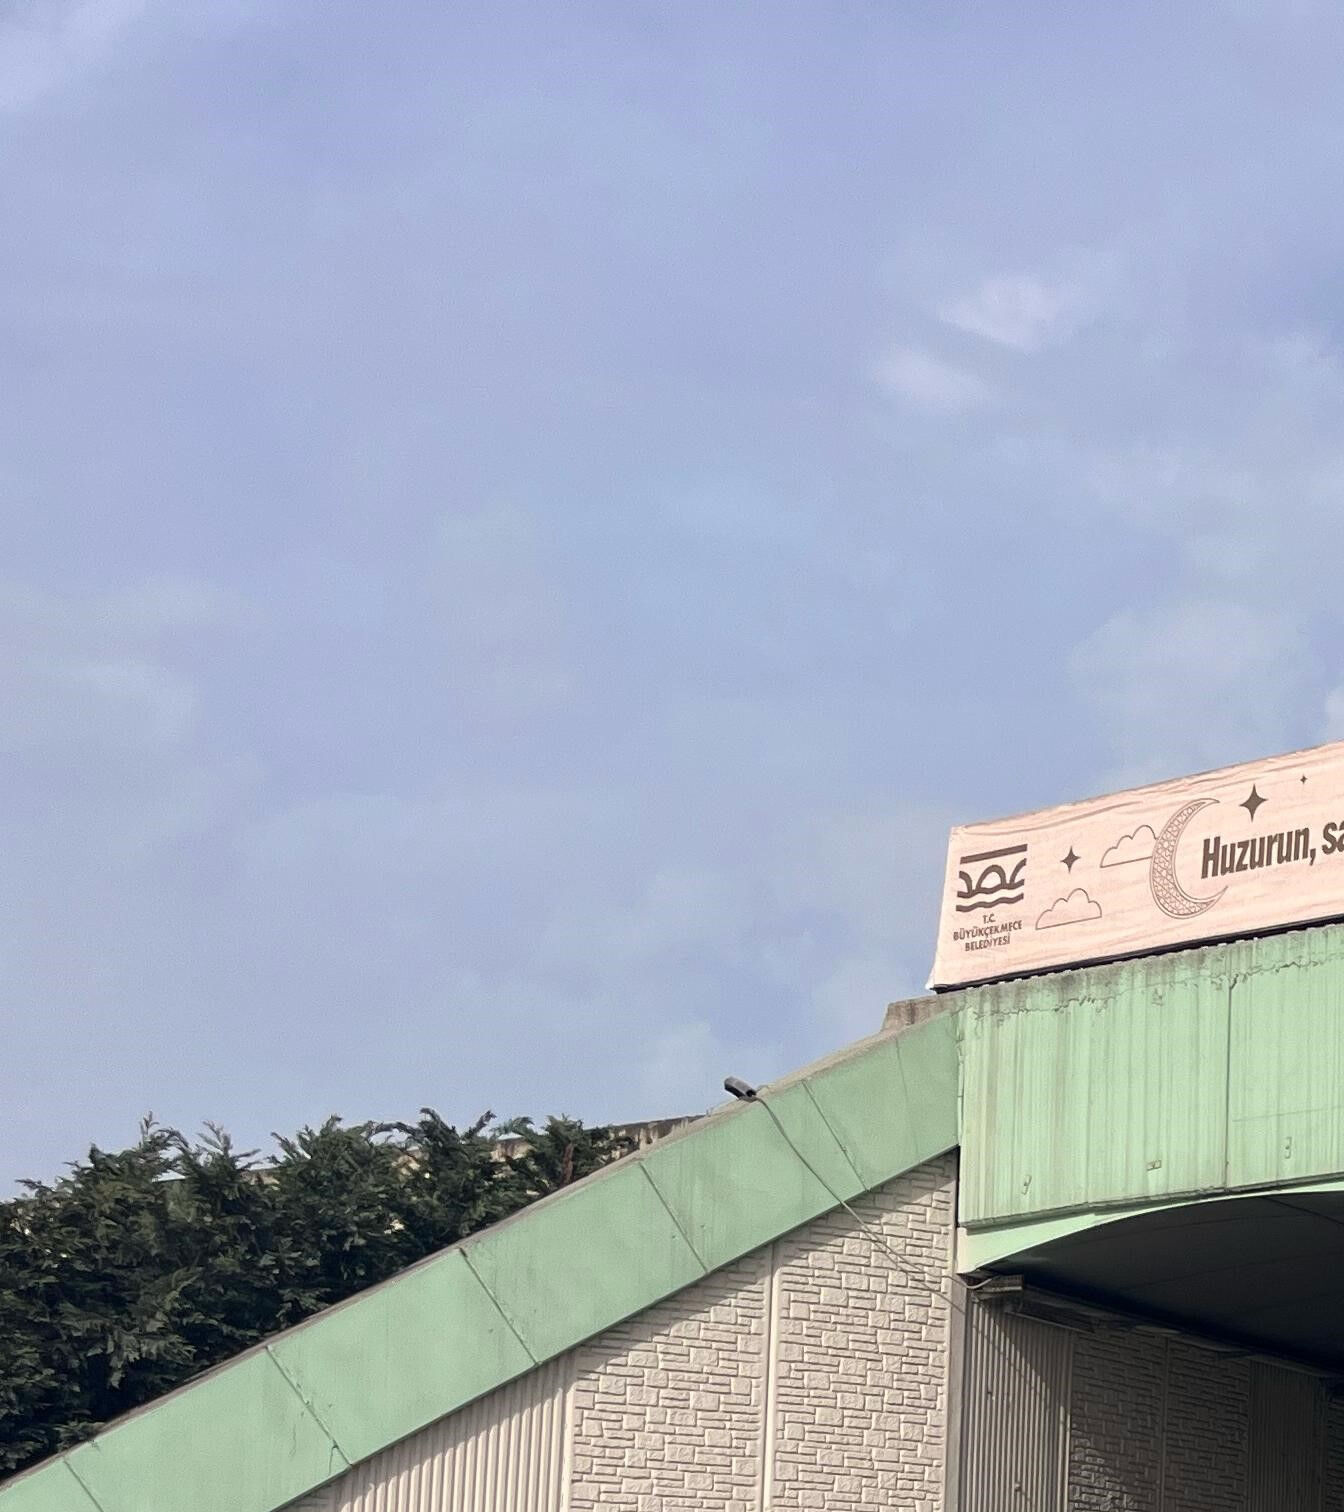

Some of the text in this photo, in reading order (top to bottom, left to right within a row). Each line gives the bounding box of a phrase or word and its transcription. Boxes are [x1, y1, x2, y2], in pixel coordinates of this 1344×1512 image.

[1201, 826, 1316, 879] Huzurun,
[953, 920, 1023, 941] BÜYÜKÇEKMECE
[964, 932, 1011, 951] BELEDİYESİ
